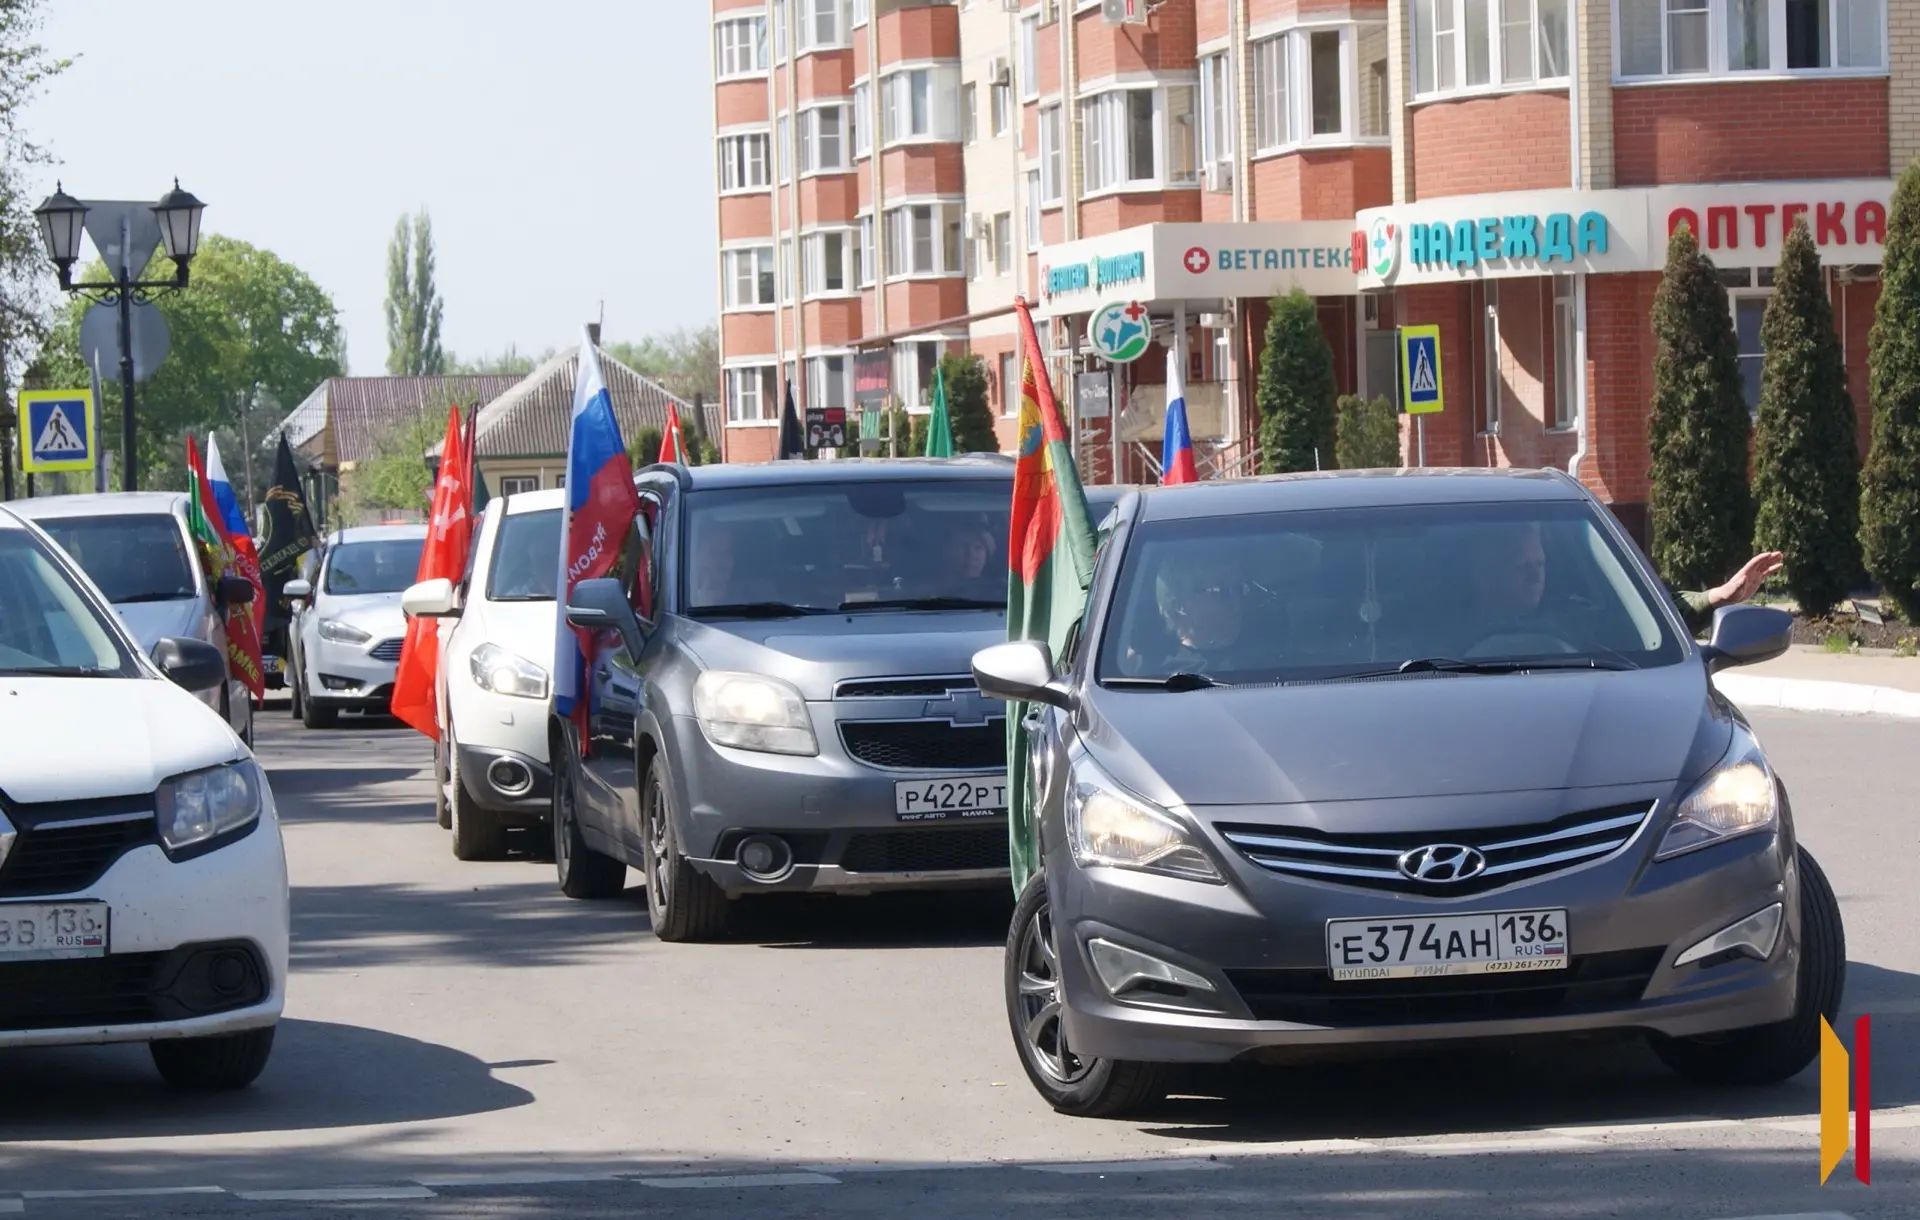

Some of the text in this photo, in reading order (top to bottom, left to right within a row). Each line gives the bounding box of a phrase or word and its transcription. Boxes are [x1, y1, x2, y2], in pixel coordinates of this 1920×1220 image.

[1668, 200, 1887, 250] АПТЕКА
[1409, 210, 1608, 269] НАДЕЖДА
[905, 782, 1006, 810] Р422РТ
[47, 908, 95, 935] 136
[56, 935, 82, 946] RUS
[1342, 913, 1556, 965] Е374АН 136
[1515, 944, 1543, 956] RUS
[1338, 968, 1390, 979] HYUNDAI
[1485, 959, 1562, 972] (473) 261-7777
